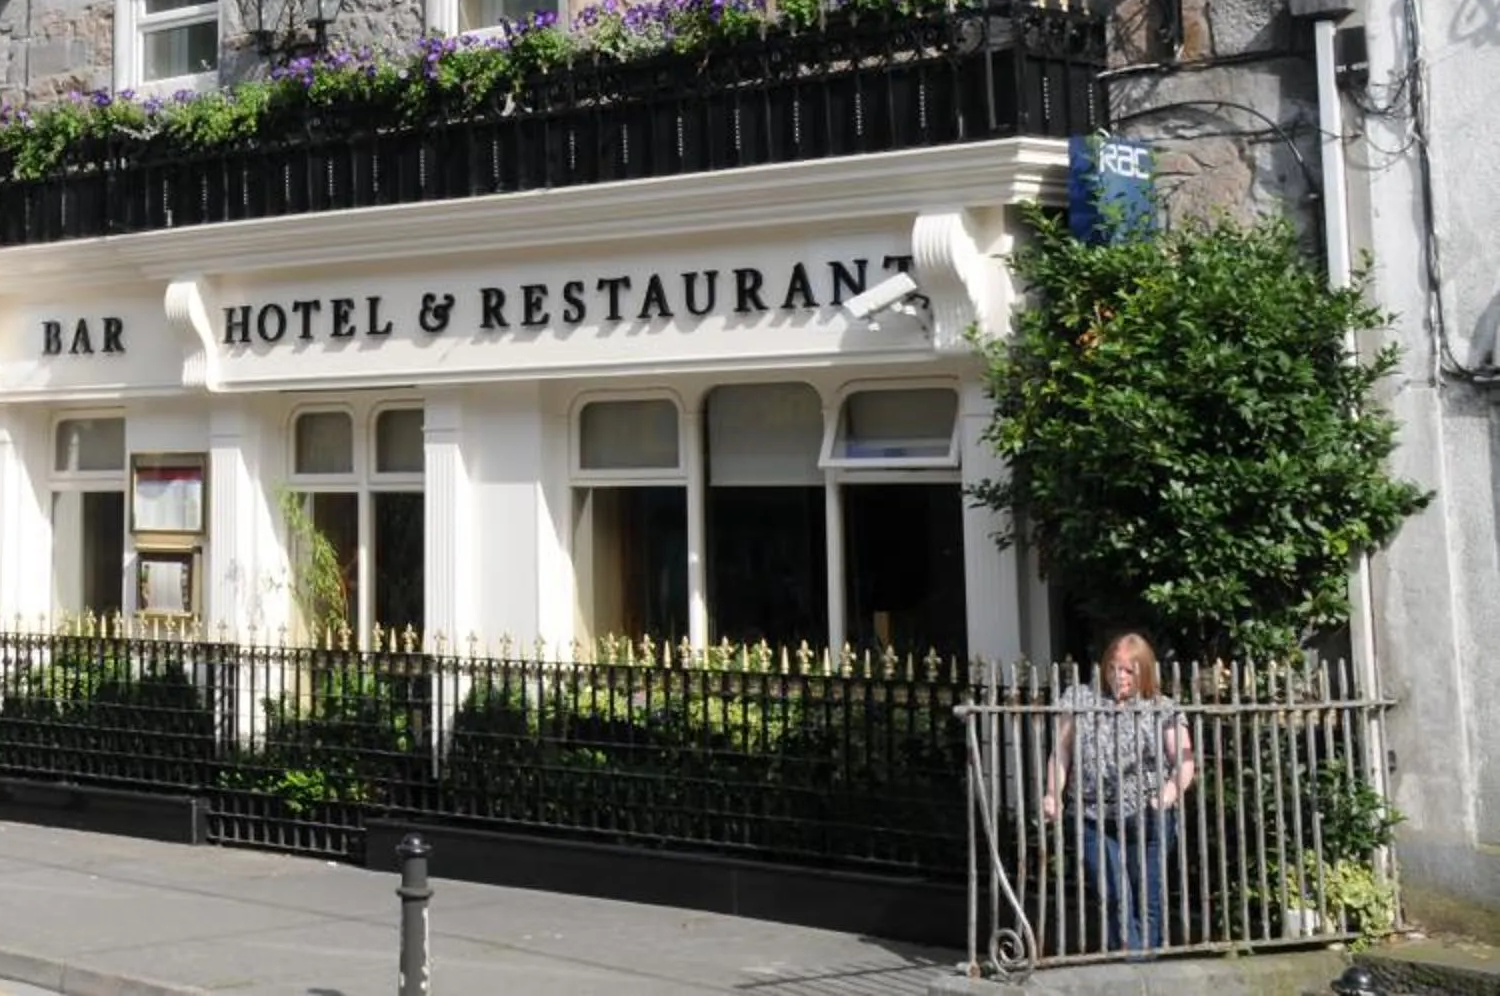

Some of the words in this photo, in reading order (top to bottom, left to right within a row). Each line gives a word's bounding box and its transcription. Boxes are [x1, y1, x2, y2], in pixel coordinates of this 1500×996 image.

[41, 317, 125, 356] BAR
[223, 296, 393, 344] HOTEL
[418, 293, 456, 333] &
